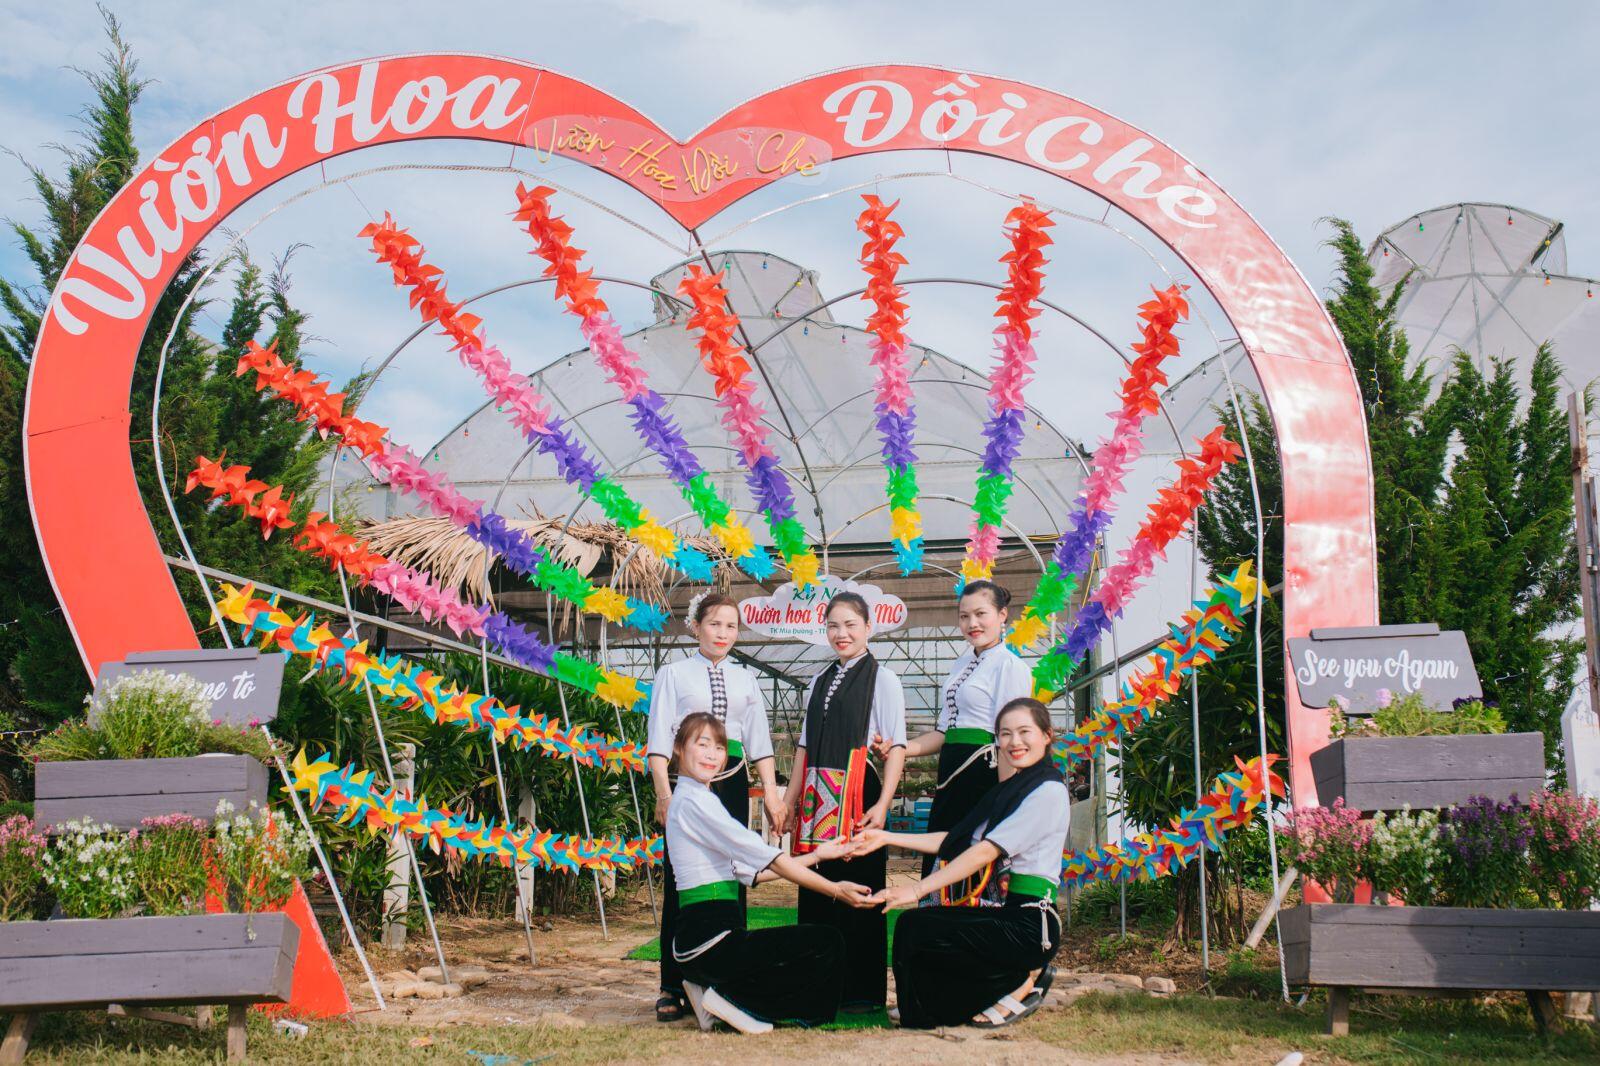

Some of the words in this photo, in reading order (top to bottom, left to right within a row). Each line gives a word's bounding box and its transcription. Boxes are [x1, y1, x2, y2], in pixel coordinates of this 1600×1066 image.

[619, 138, 678, 190] Hoa
[756, 131, 821, 177] Chè
[52, 113, 288, 335] Vườn
[287, 61, 529, 153] Hoa
[822, 74, 1027, 148] Đồi
[1025, 115, 1218, 229] Chè
[743, 603, 782, 625] Vườn
[785, 602, 812, 624] hoa
[874, 603, 903, 625] MC
[232, 670, 256, 700] to
[1298, 649, 1340, 686] See
[1344, 657, 1382, 689] you
[1384, 649, 1459, 693] Again
